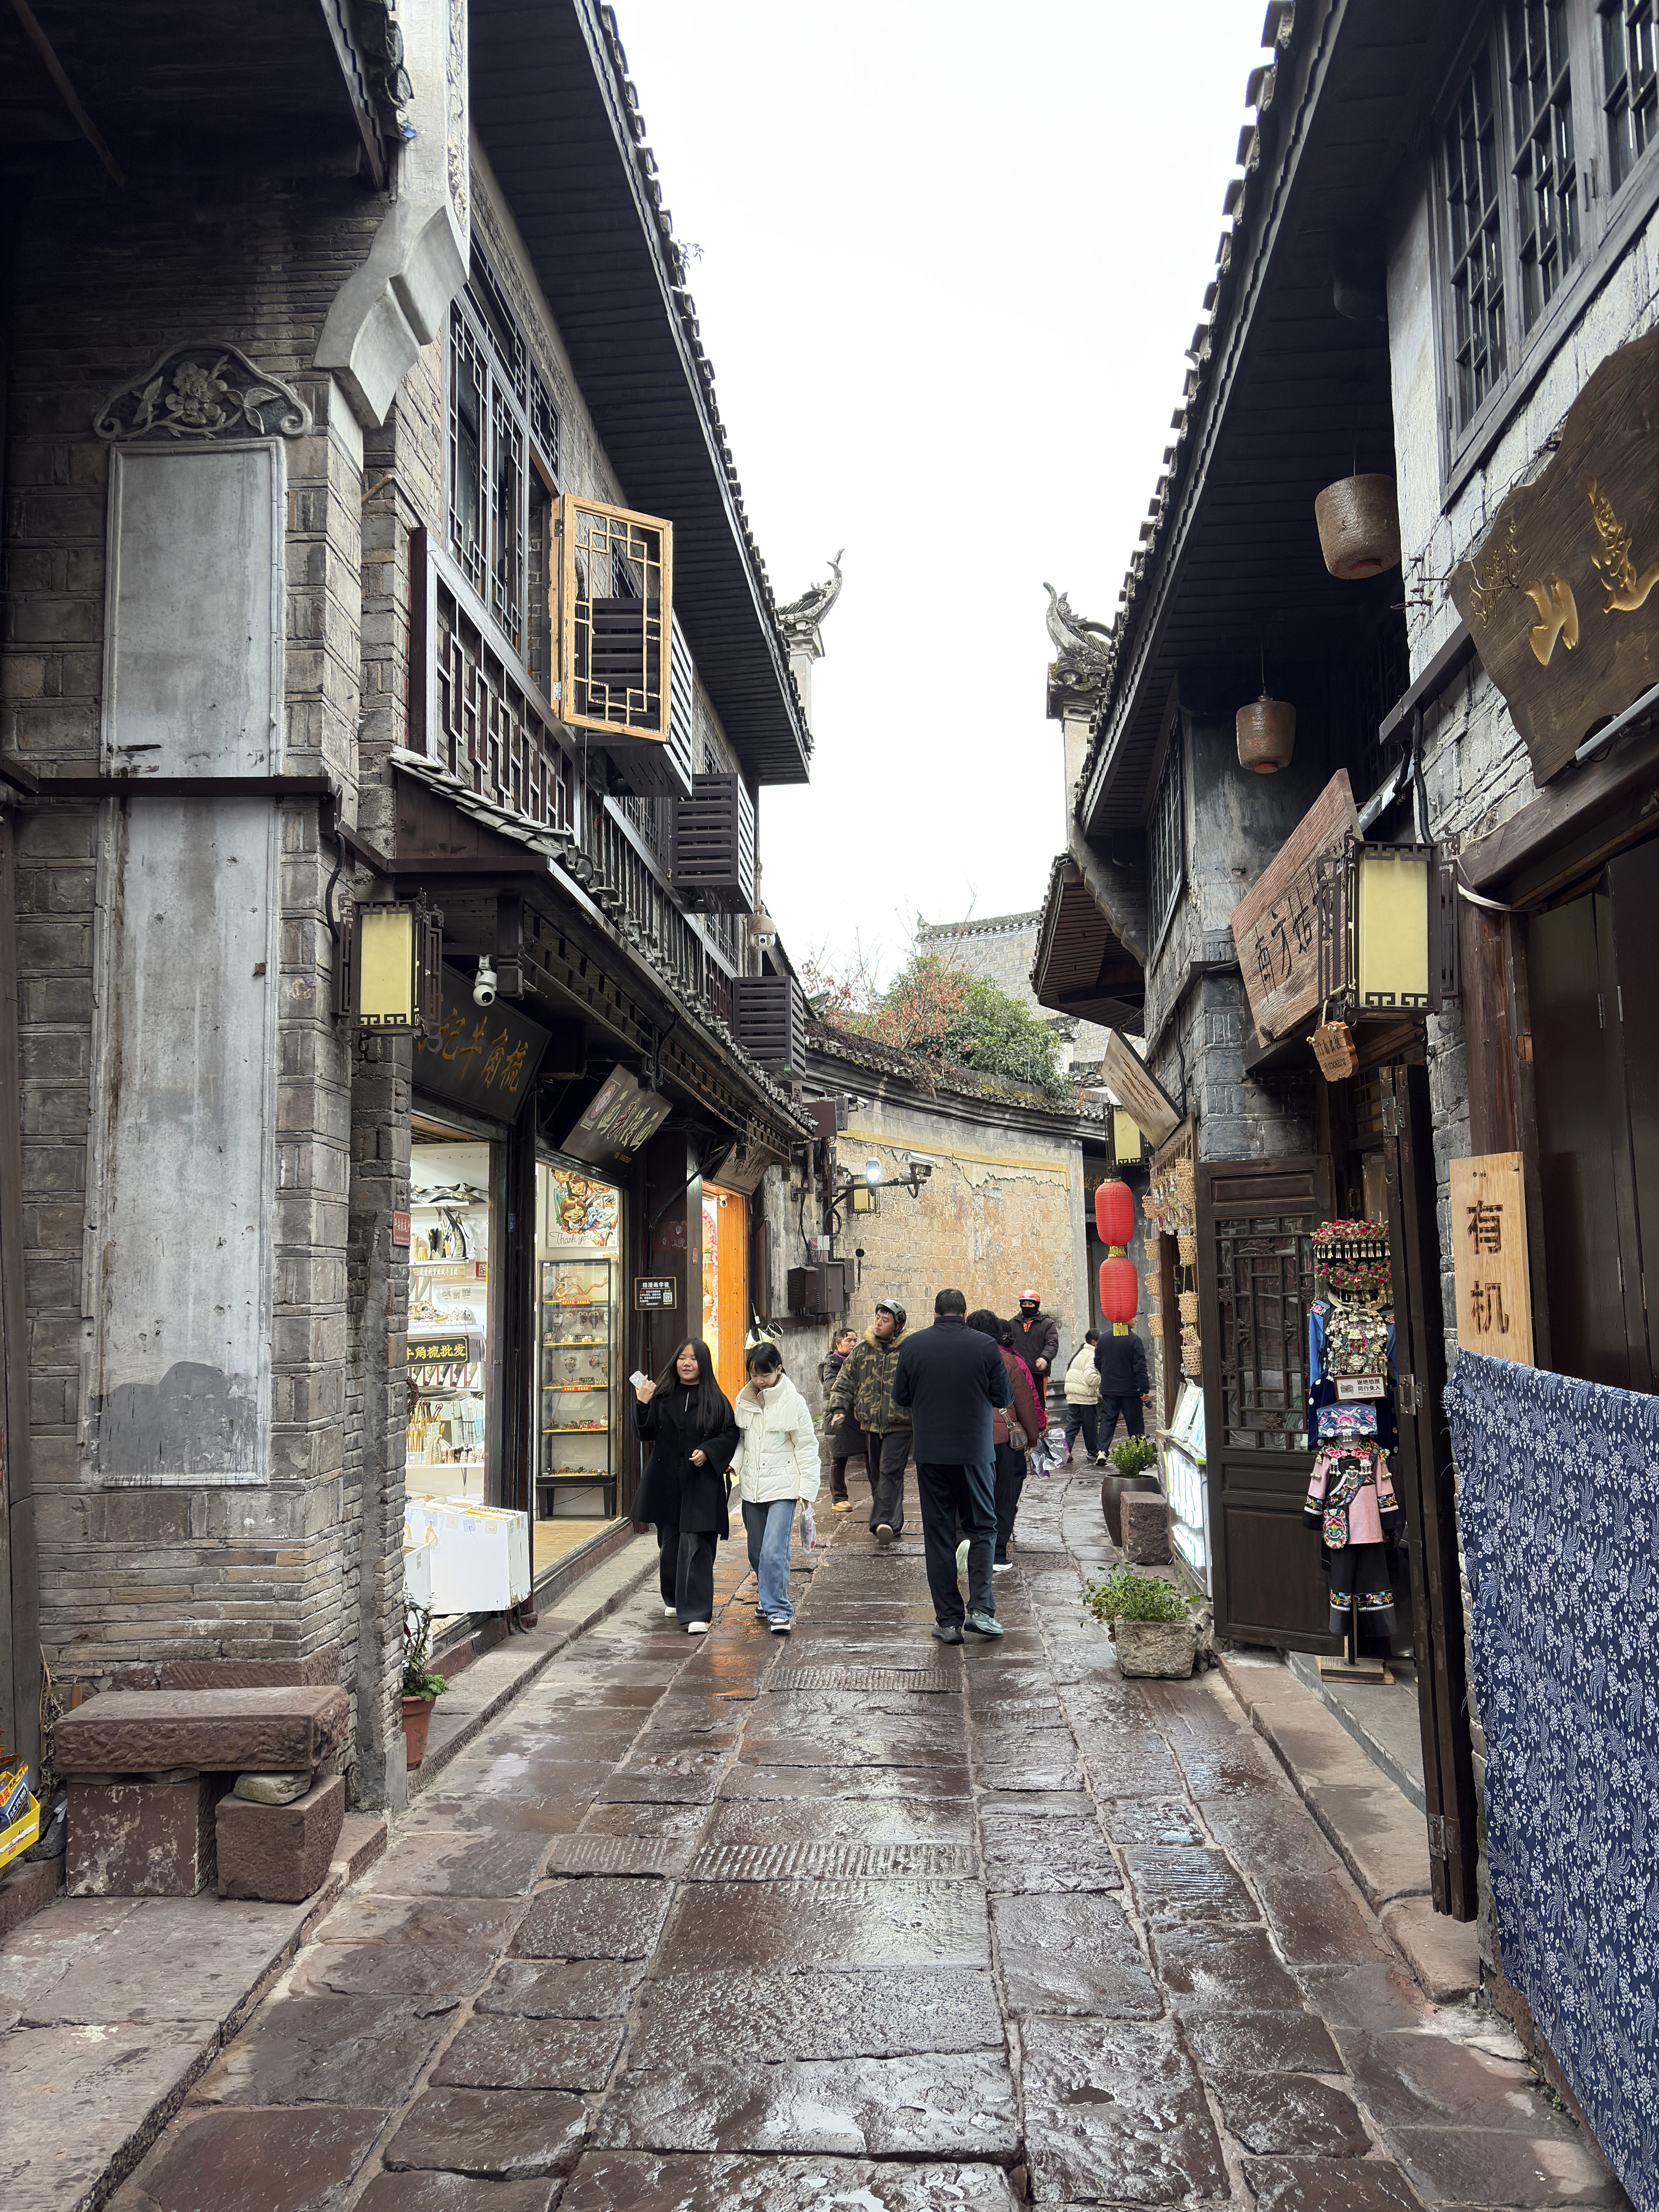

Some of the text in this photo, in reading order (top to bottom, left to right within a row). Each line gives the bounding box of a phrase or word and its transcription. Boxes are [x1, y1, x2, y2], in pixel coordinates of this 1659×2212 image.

[418, 1006, 529, 1093] 记牛角梳
[549, 1231, 576, 1245] Thank
[578, 1230, 616, 1245] you
[1467, 1201, 1510, 1335] 有机
